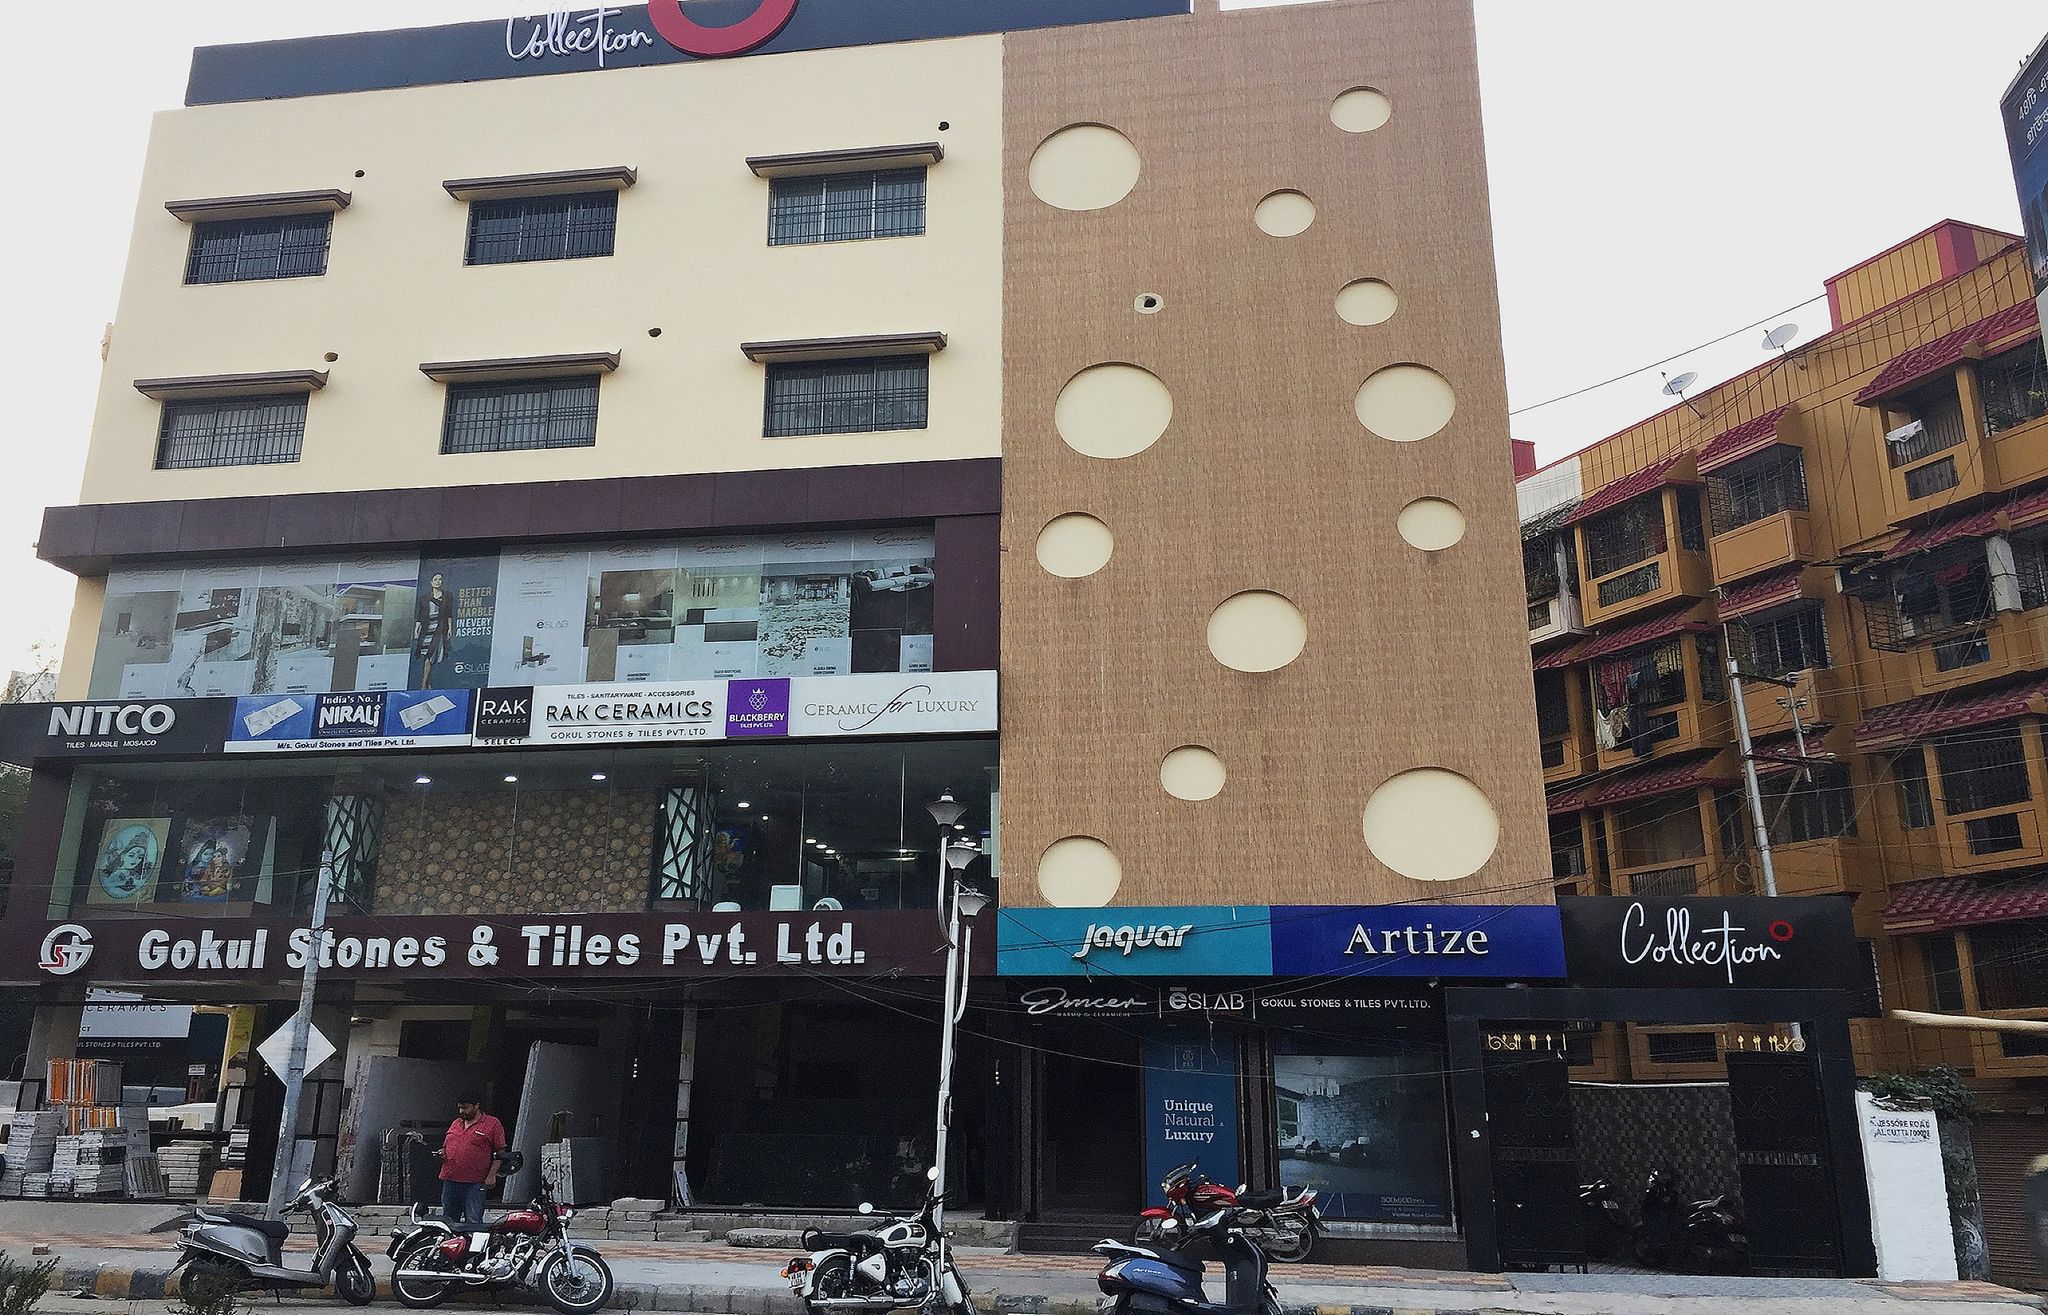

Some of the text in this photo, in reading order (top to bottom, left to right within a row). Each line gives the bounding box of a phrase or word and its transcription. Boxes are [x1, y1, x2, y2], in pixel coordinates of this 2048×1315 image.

[459, 587, 492, 597] BETTER
[459, 598, 482, 607] THAN
[457, 606, 494, 618] MARBLE
[456, 617, 492, 628] IN EVERY
[455, 627, 492, 637] ASPECTS
[322, 695, 355, 704] India's
[357, 695, 373, 703] No.
[591, 691, 643, 699] SANITARYWARE
[482, 699, 529, 715] RAK
[546, 701, 713, 721] RAK CERAMICS
[838, 685, 931, 731] for
[47, 704, 176, 736] NITCO
[481, 717, 527, 725] CERAMICS
[729, 713, 785, 722] BLACKBERRY
[550, 732, 582, 740] GOKUL
[587, 731, 622, 739] STONES
[627, 730, 634, 738] &
[638, 729, 662, 737] TILES
[66, 739, 157, 749] TILES MARBLE MOSAICO
[294, 741, 317, 749] Gokul
[319, 740, 345, 748] Stones
[365, 739, 383, 747] Tiles
[401, 738, 416, 746] Ltd.
[484, 737, 523, 745] SELECT
[1071, 923, 1194, 959] Jaquar
[1344, 923, 1489, 955] Artize
[1621, 902, 1782, 984] Collection
[138, 921, 866, 970] Gokul Stones & Tiles Pvt. Ltd.
[1261, 998, 1431, 1009] GOKUL STONES & TILES PVT. LTD.
[1164, 1099, 1214, 1114] Unique
[1164, 1113, 1215, 1127] Natural
[1164, 1128, 1215, 1144] Luxury
